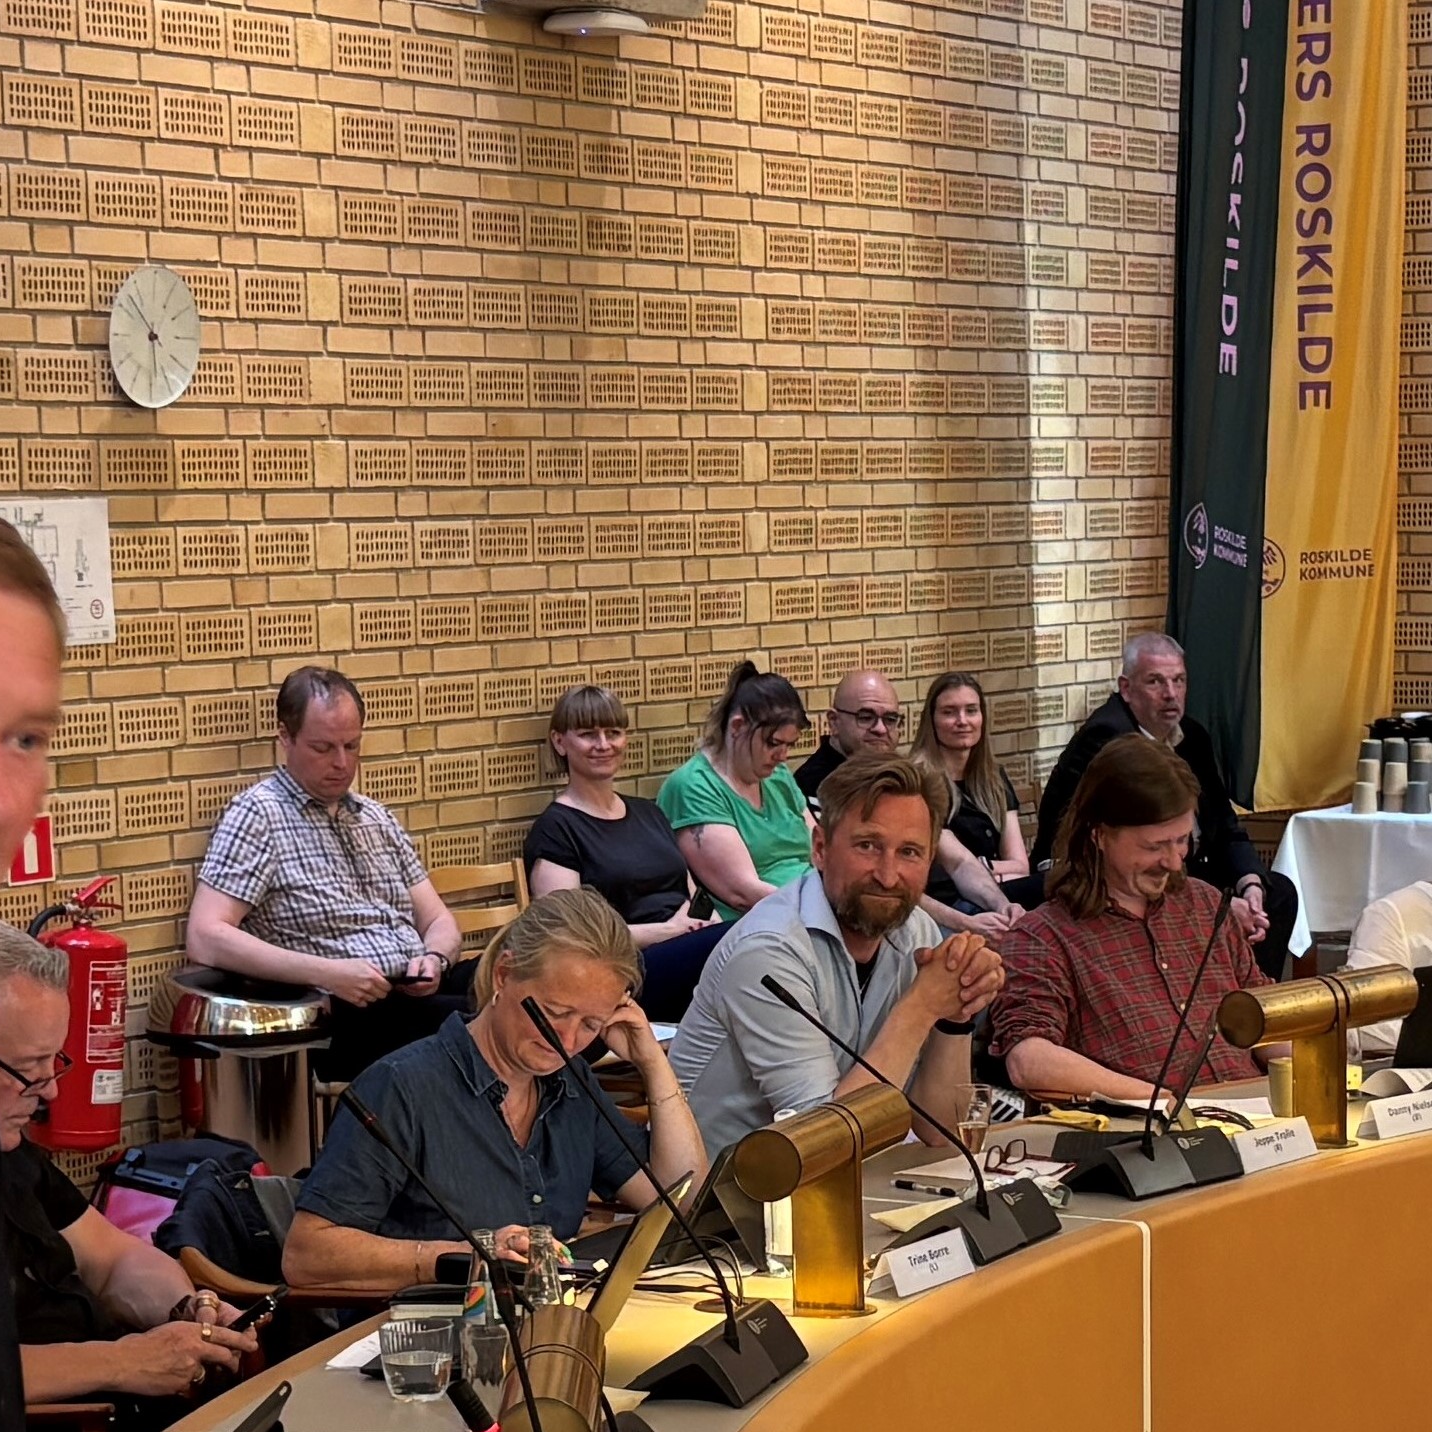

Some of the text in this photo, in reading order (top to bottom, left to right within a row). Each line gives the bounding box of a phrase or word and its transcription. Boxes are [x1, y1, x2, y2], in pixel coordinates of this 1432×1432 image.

[1295, 123, 1333, 411] ROSKILDE
[1214, 525, 1247, 549] ROSKILDE
[1213, 546, 1248, 567] KOMMUNE
[1300, 549, 1373, 564] ROSKILDE
[1299, 564, 1375, 581] KOMMUNE
[908, 1254, 928, 1267] Trine
